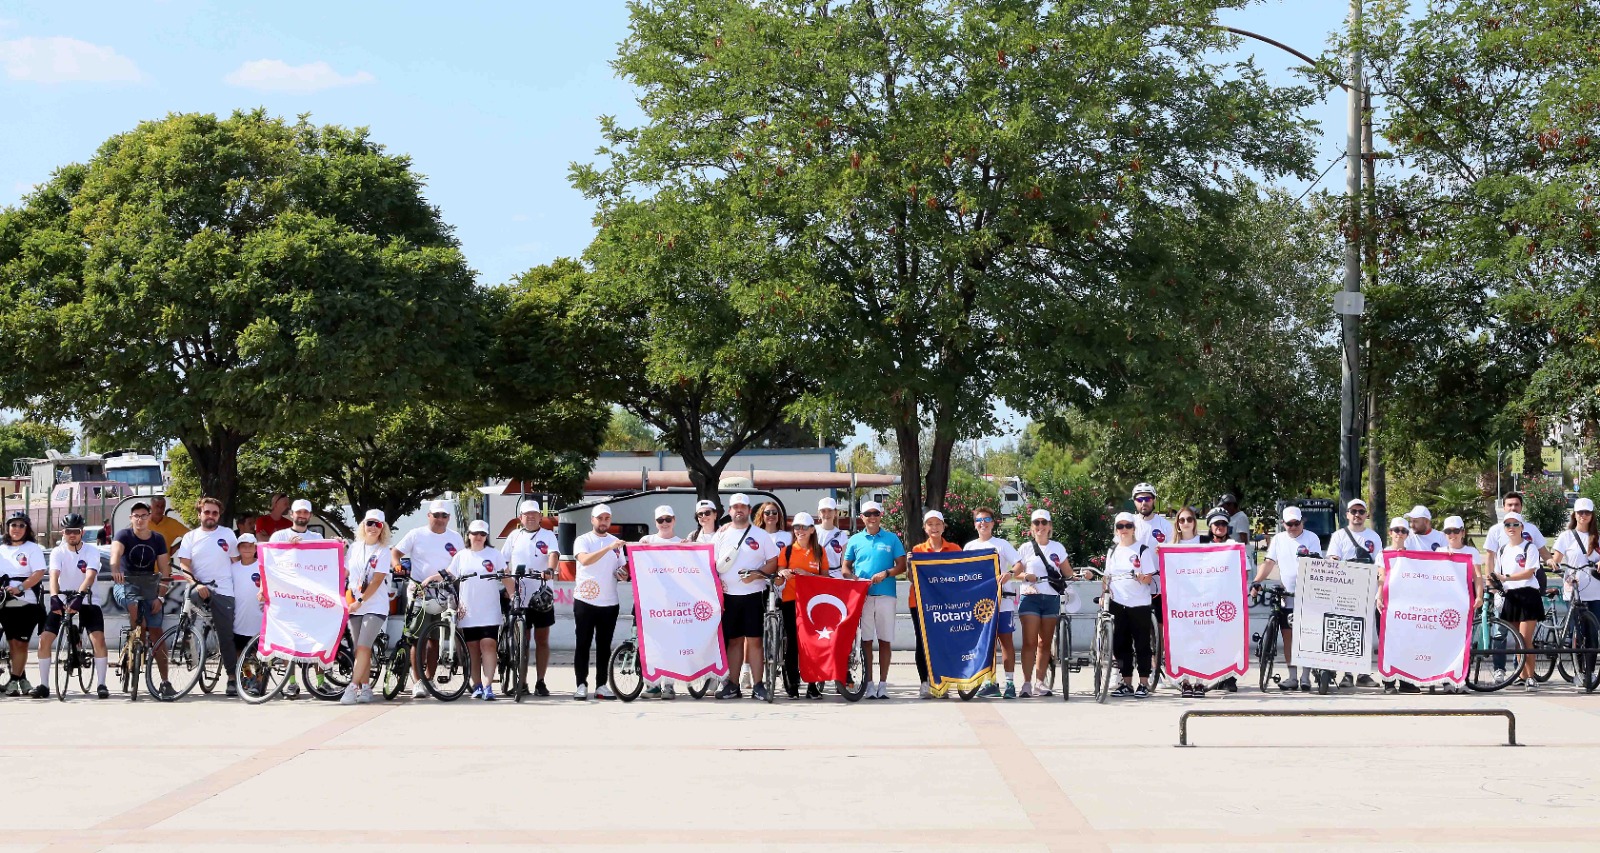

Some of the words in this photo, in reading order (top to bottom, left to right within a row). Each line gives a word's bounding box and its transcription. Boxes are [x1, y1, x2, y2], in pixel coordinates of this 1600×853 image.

[1326, 576, 1354, 585] PEDALA!
[650, 608, 692, 618] Rotaract
[933, 611, 972, 623] Rotary
[1171, 609, 1214, 618] Rotaract
[1394, 611, 1437, 622] Rotaract
